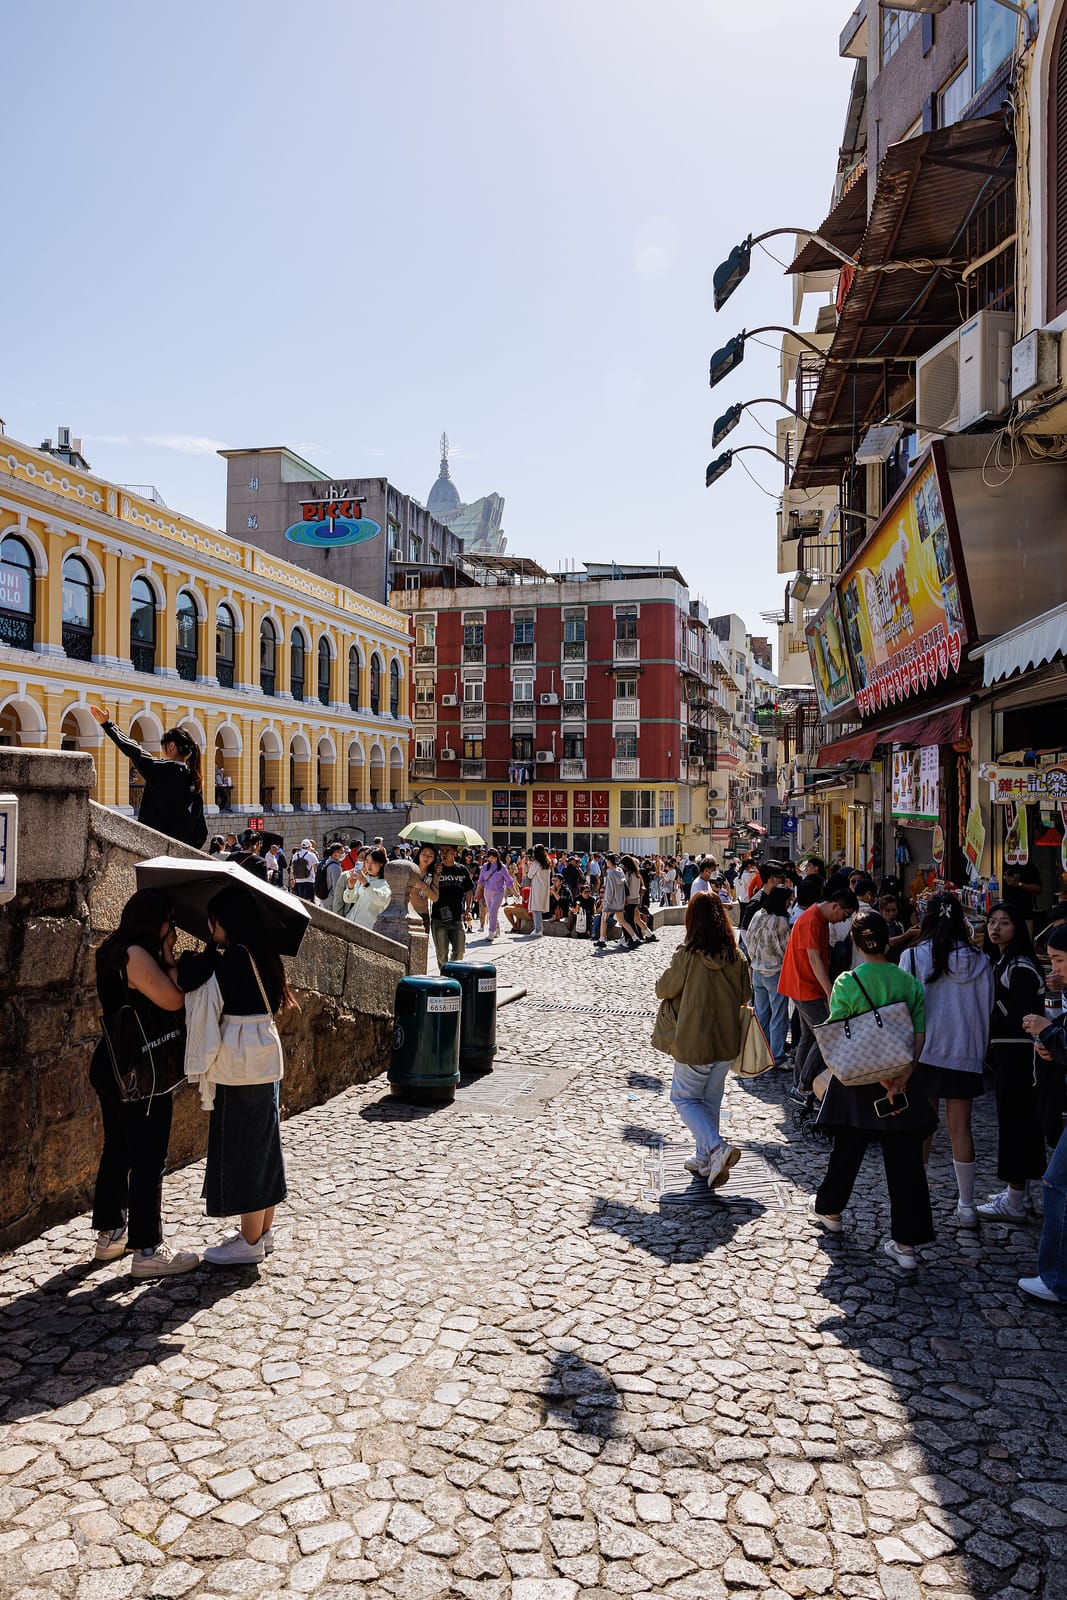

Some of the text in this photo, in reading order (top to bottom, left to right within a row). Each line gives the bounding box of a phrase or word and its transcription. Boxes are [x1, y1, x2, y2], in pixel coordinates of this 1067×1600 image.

[0, 573, 19, 589] UNI
[0, 589, 21, 604] QLO
[534, 813, 567, 823] 6268
[575, 813, 608, 823] 1521
